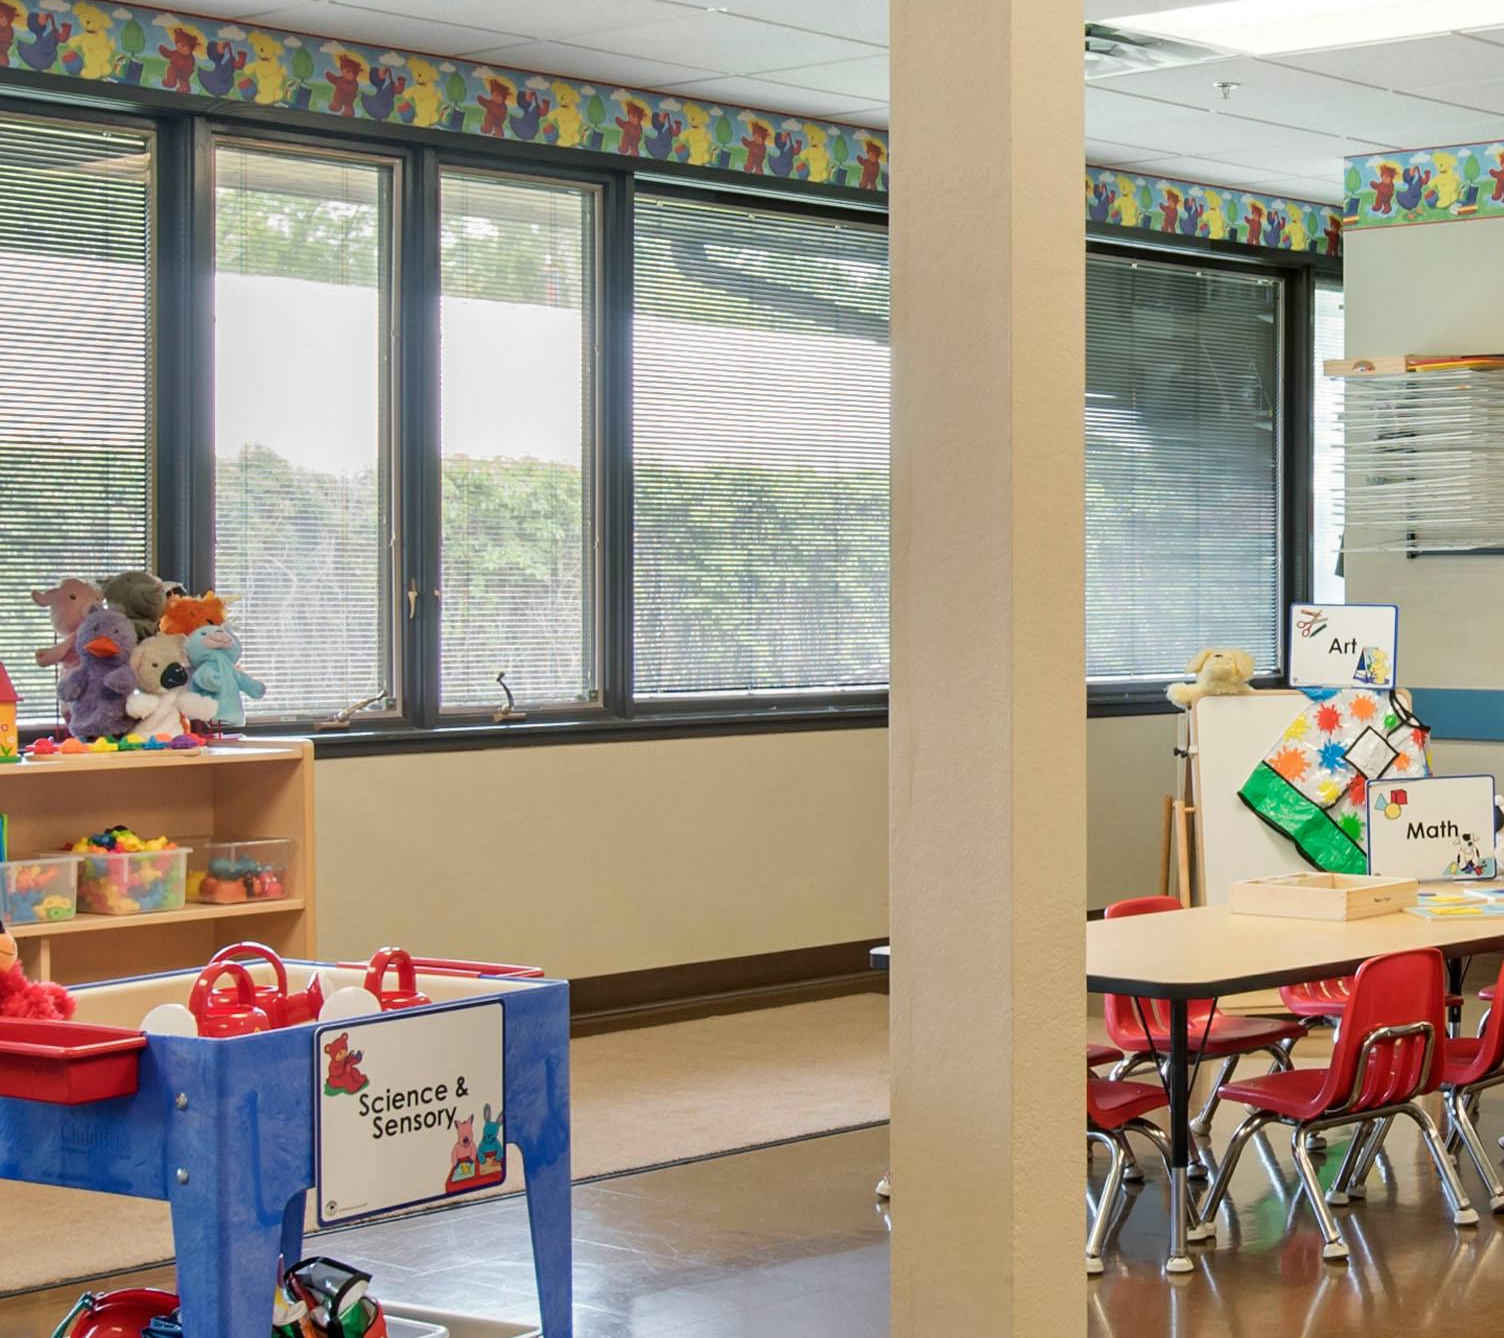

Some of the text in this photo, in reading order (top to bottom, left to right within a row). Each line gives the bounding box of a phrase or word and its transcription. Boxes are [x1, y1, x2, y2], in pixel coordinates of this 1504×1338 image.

[1328, 637, 1357, 654] Art
[1406, 820, 1459, 840] Math
[359, 1076, 469, 1117] Science &
[372, 1106, 457, 1140] Sensory
